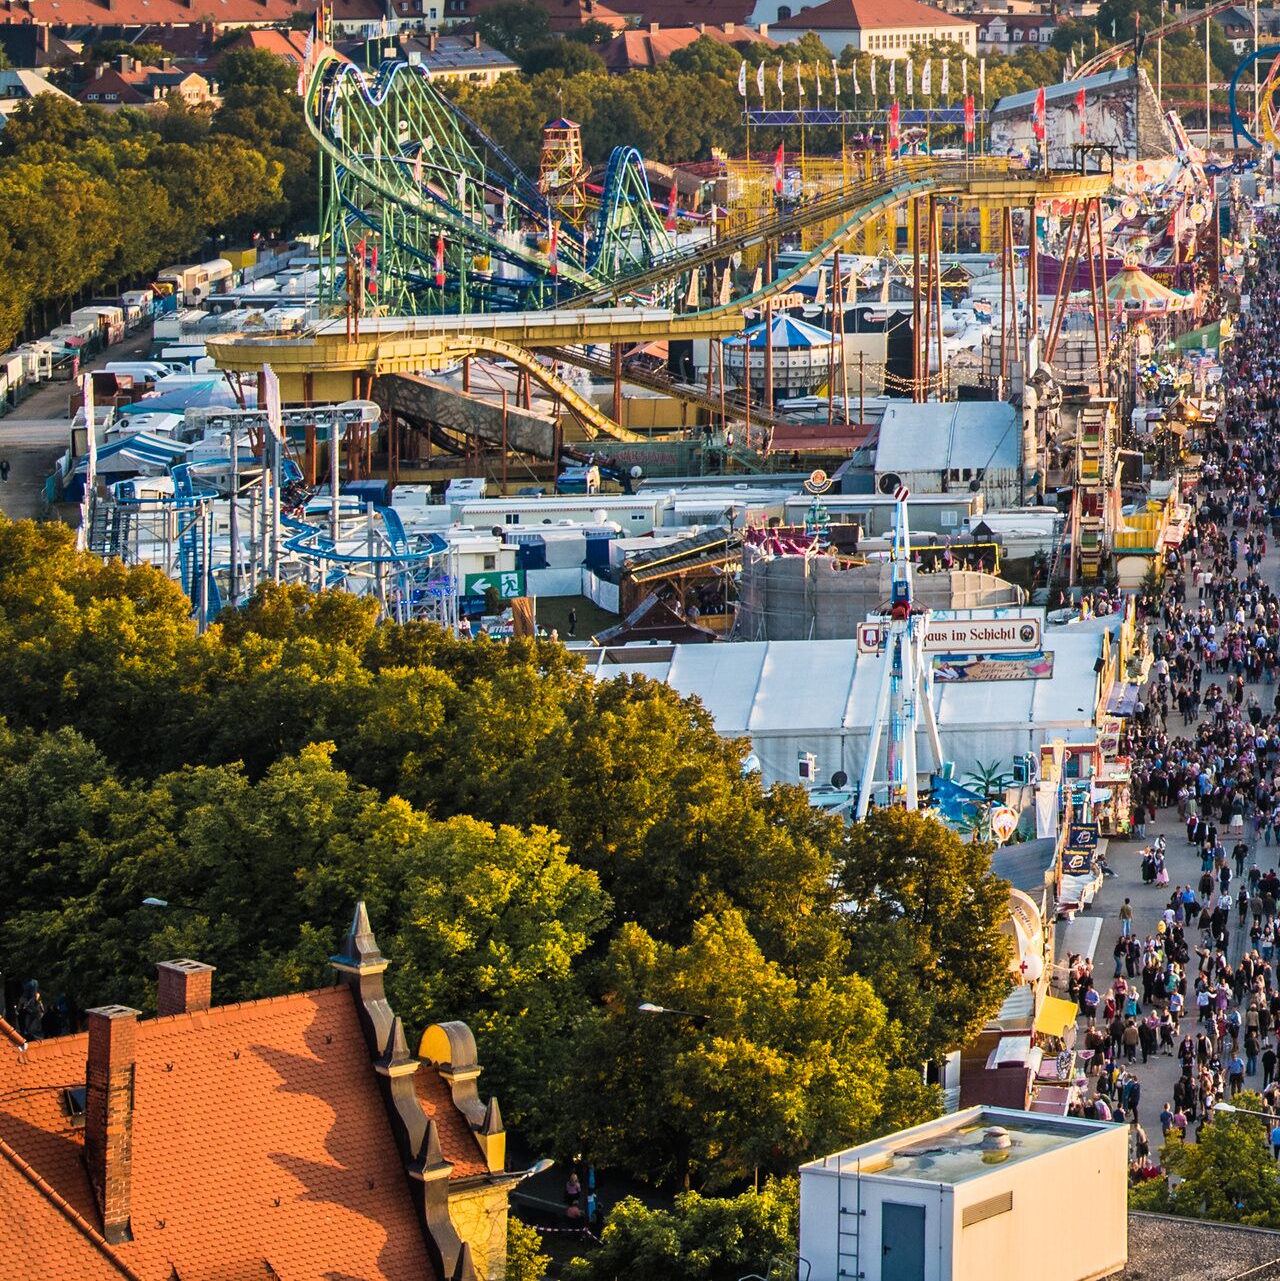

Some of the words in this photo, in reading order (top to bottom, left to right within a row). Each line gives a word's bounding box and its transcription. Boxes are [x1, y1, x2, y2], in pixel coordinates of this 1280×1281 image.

[762, 292, 804, 311] OTOR
[951, 629, 967, 643] im
[970, 627, 1016, 642] Schichtl
